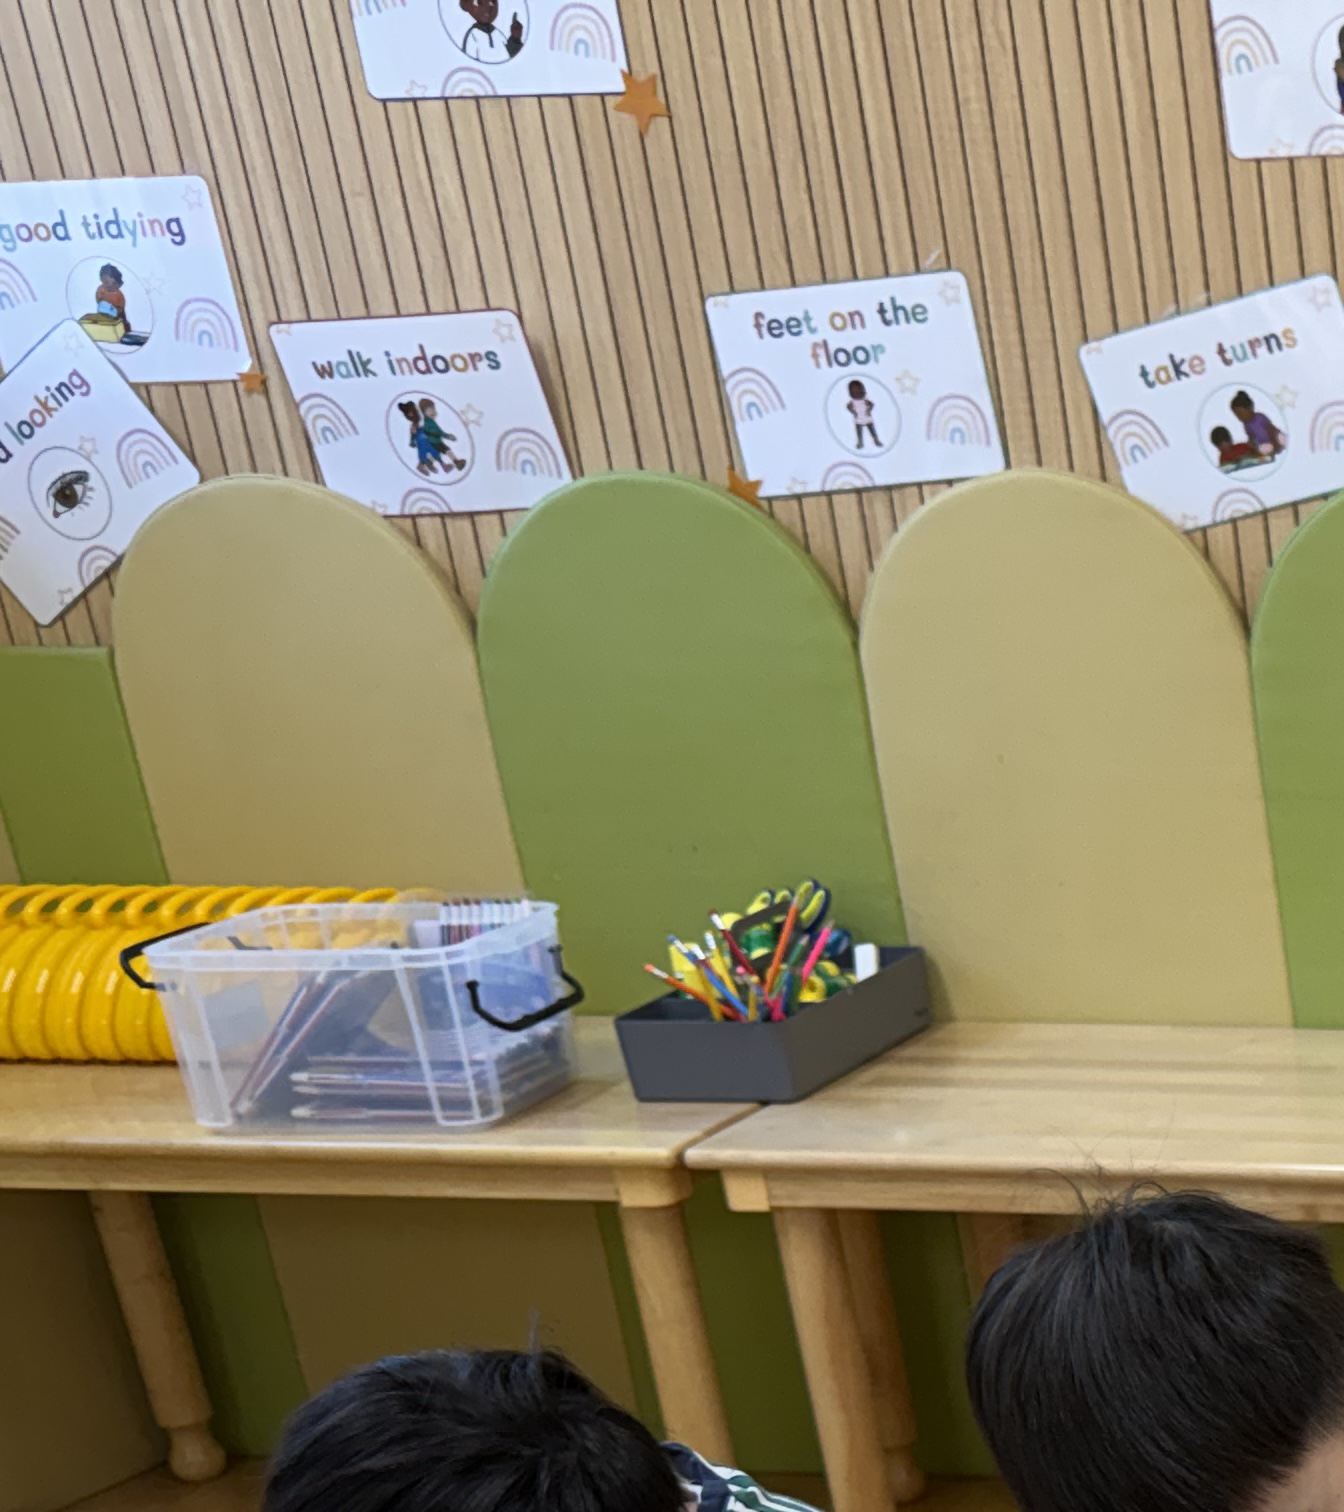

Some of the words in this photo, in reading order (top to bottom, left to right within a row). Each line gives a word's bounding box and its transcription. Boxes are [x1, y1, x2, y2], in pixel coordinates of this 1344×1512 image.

[0, 209, 71, 252] good
[81, 207, 186, 248] tidying
[753, 311, 818, 339] feet
[829, 309, 866, 332] on
[876, 297, 929, 327] the
[312, 349, 377, 380] walk
[384, 343, 501, 376] indoors
[811, 341, 886, 369] floor
[1139, 353, 1206, 389] take
[1216, 328, 1298, 366] turns
[4, 368, 91, 446] looking
